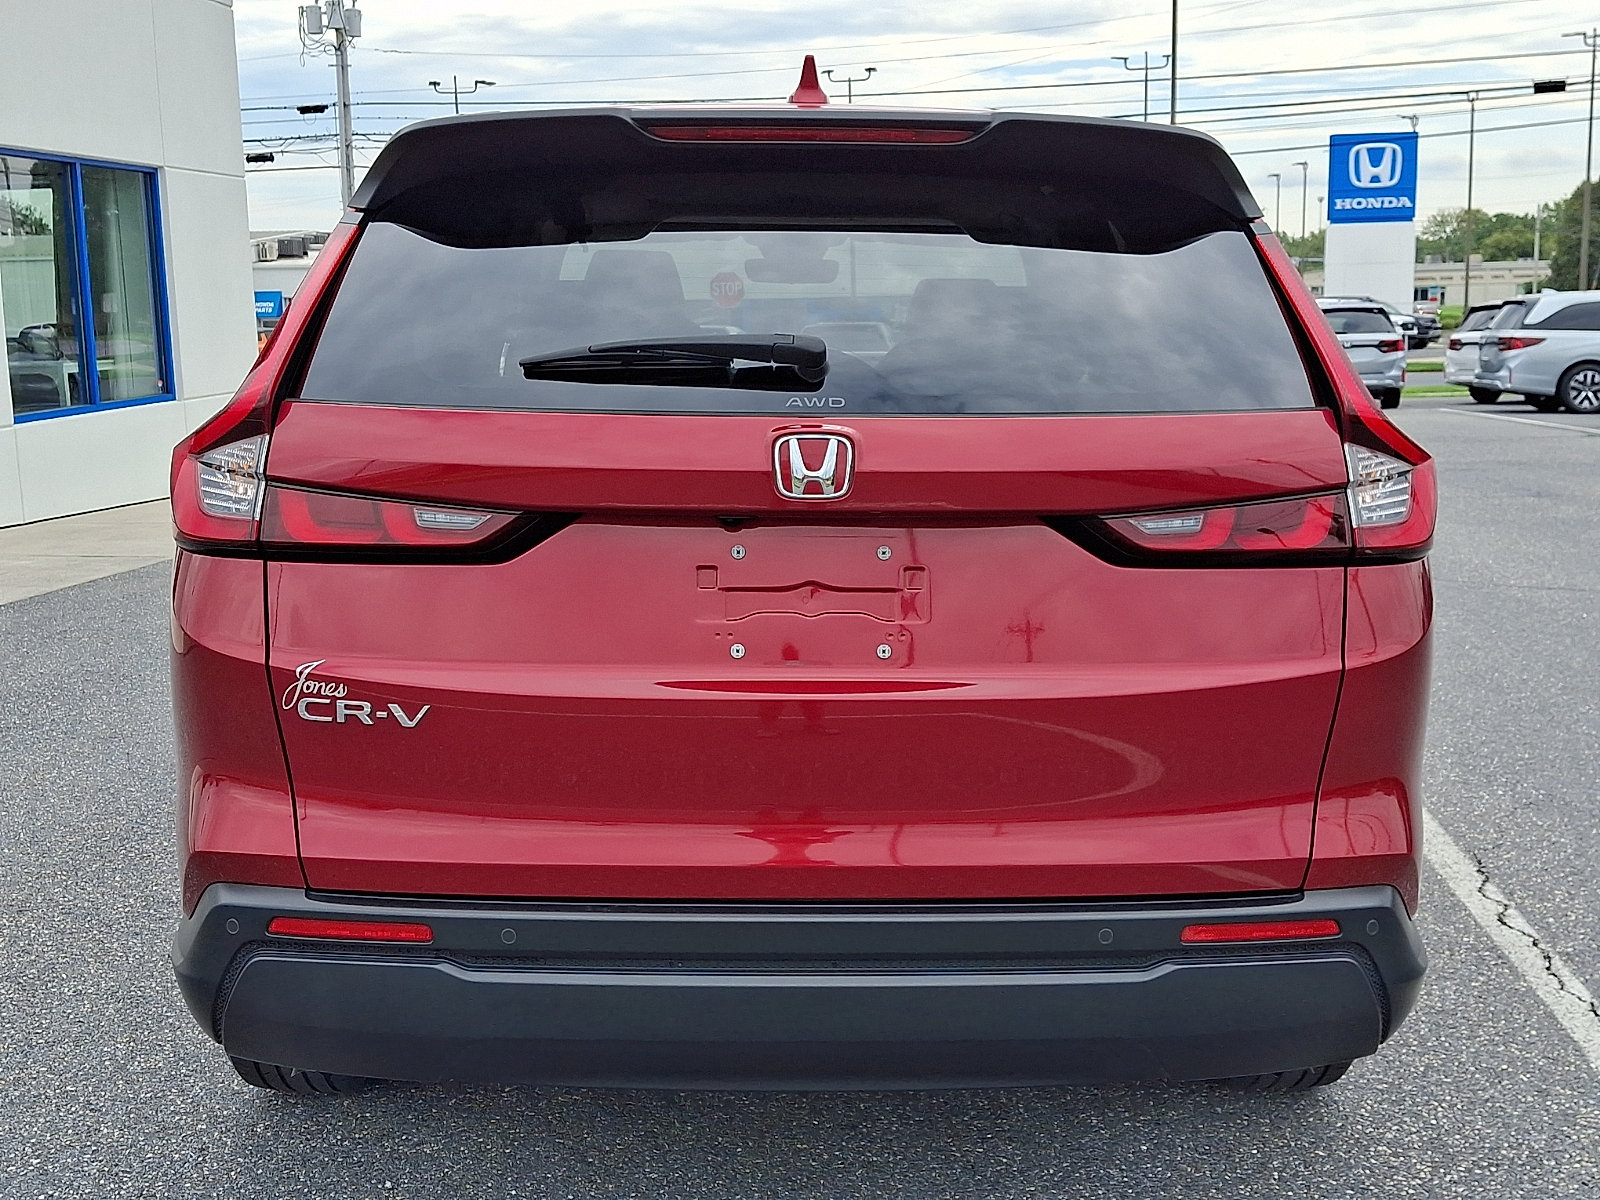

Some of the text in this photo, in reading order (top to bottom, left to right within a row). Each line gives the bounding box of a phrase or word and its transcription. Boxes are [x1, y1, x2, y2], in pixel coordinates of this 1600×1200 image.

[1334, 197, 1413, 210] HONDA
[711, 281, 743, 297] STOP
[785, 397, 846, 408] AWD
[282, 659, 347, 710] Jones
[297, 697, 431, 728] CR-V
